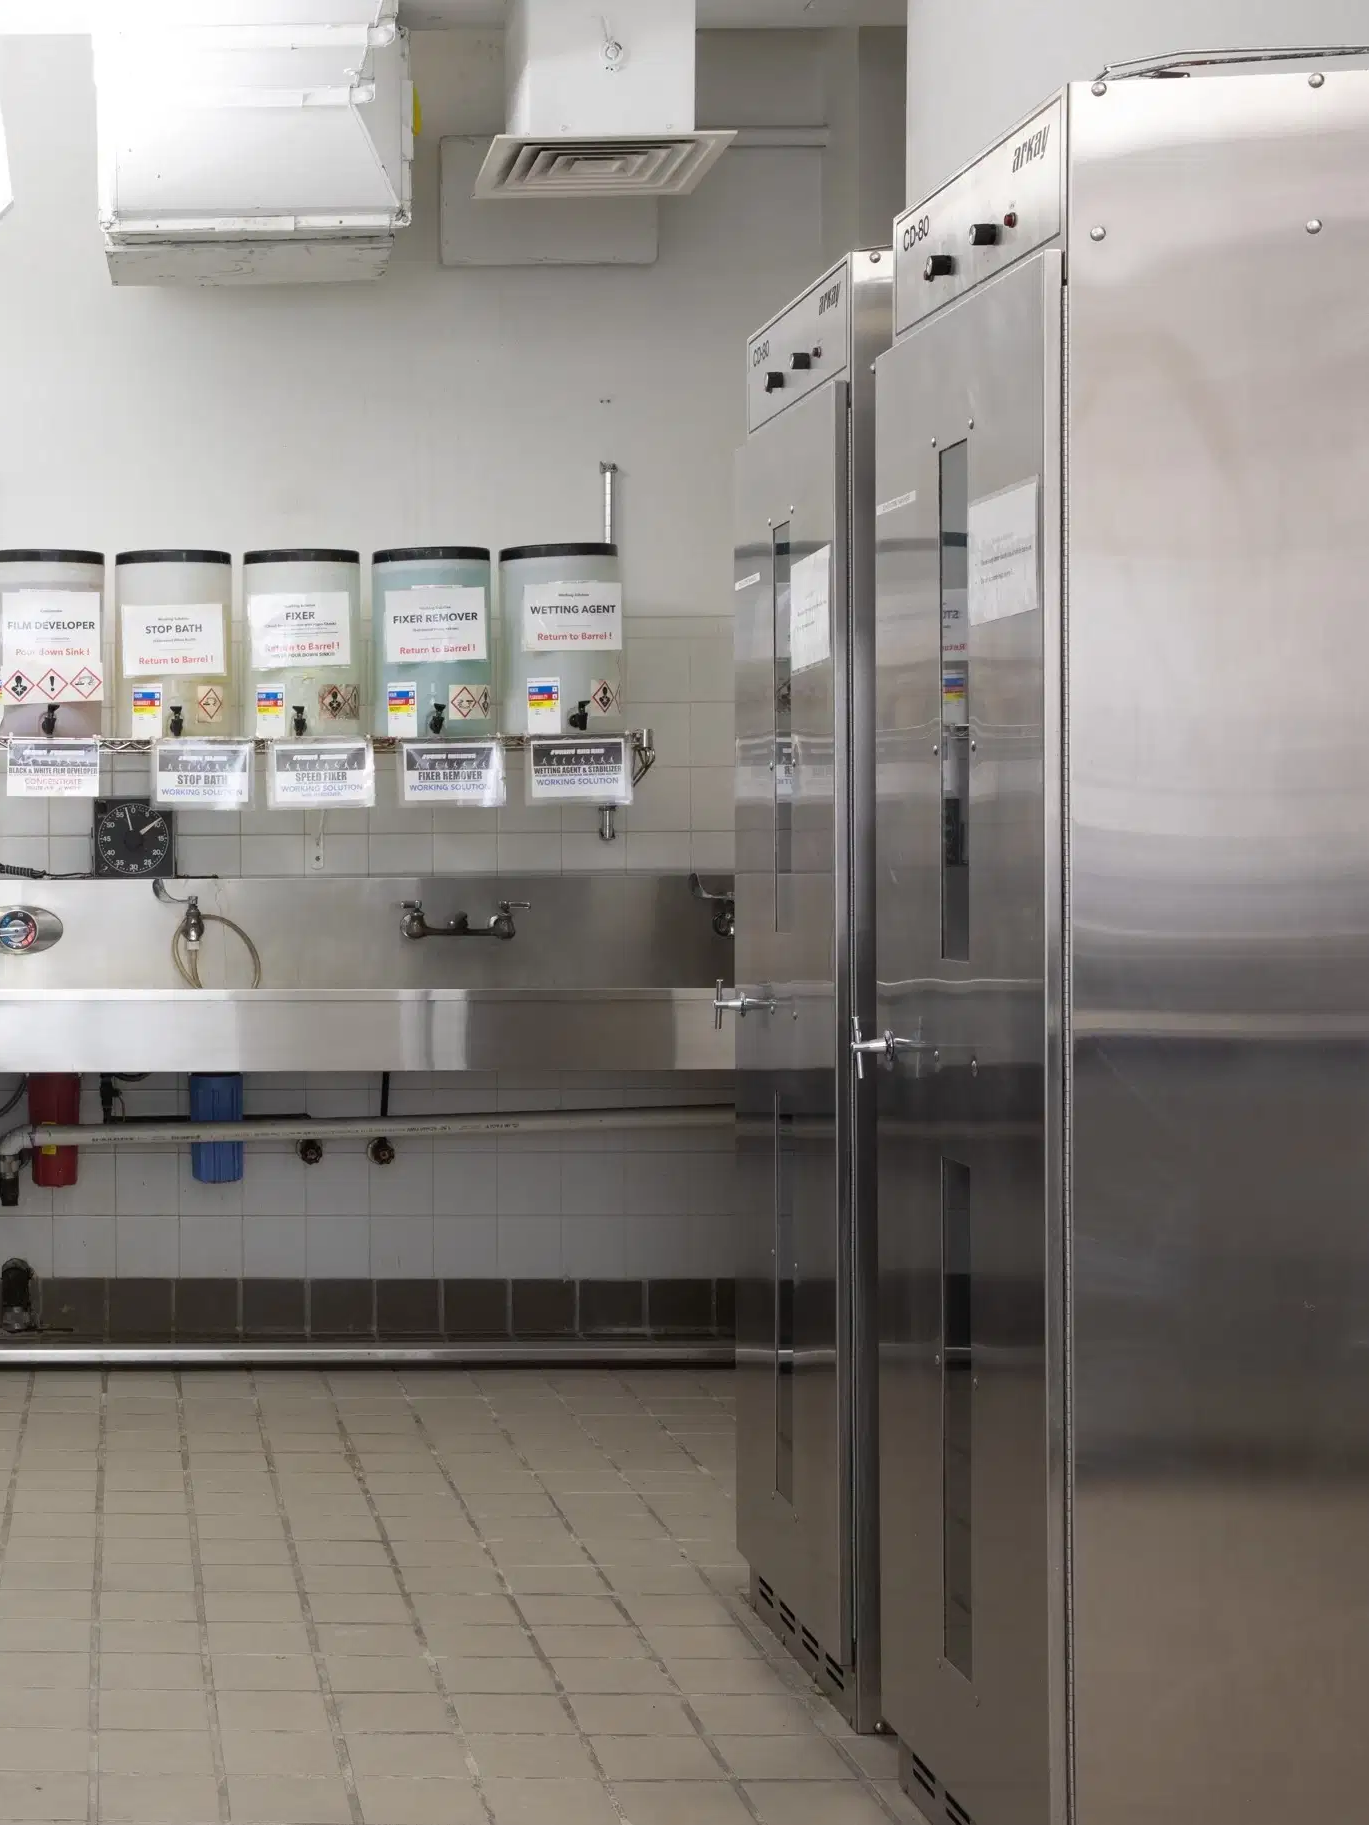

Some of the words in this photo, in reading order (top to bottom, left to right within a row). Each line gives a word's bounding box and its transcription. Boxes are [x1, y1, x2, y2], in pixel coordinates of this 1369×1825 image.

[1012, 124, 1050, 173] arkay
[903, 215, 930, 252] CD-80
[819, 280, 841, 316] arkay
[530, 605, 579, 615] WETTING
[581, 604, 616, 614] AGENT
[285, 611, 315, 620] FIXER
[393, 614, 423, 624] FIXER
[425, 612, 478, 623] REMOVER
[7, 621, 32, 630] FILM
[34, 621, 95, 630] DEVELOPER
[145, 625, 173, 634] STOP
[175, 624, 203, 633] BATH
[537, 633, 567, 641] Return
[581, 632, 607, 640] Barrel
[308, 642, 335, 650] Barrel
[399, 646, 429, 655] Return
[444, 644, 470, 653] Barrel
[39, 648, 64, 656] down
[65, 648, 84, 656] Sink
[139, 657, 169, 665] Return
[171, 656, 180, 664] to
[182, 655, 208, 663] Barrel
[534, 767, 561, 775] WETTING
[562, 766, 581, 774] AGENT
[588, 765, 622, 773] STABILIZER
[177, 774, 202, 785] STOP
[295, 772, 321, 782] SPEED
[323, 771, 347, 781] FIXER
[418, 771, 441, 781] FIXER
[442, 771, 483, 780] REMOVER
[536, 778, 576, 786] WORKING
[578, 777, 619, 785] SOLUTION
[161, 788, 200, 796] WORKING
[323, 784, 363, 792] SOLUTION
